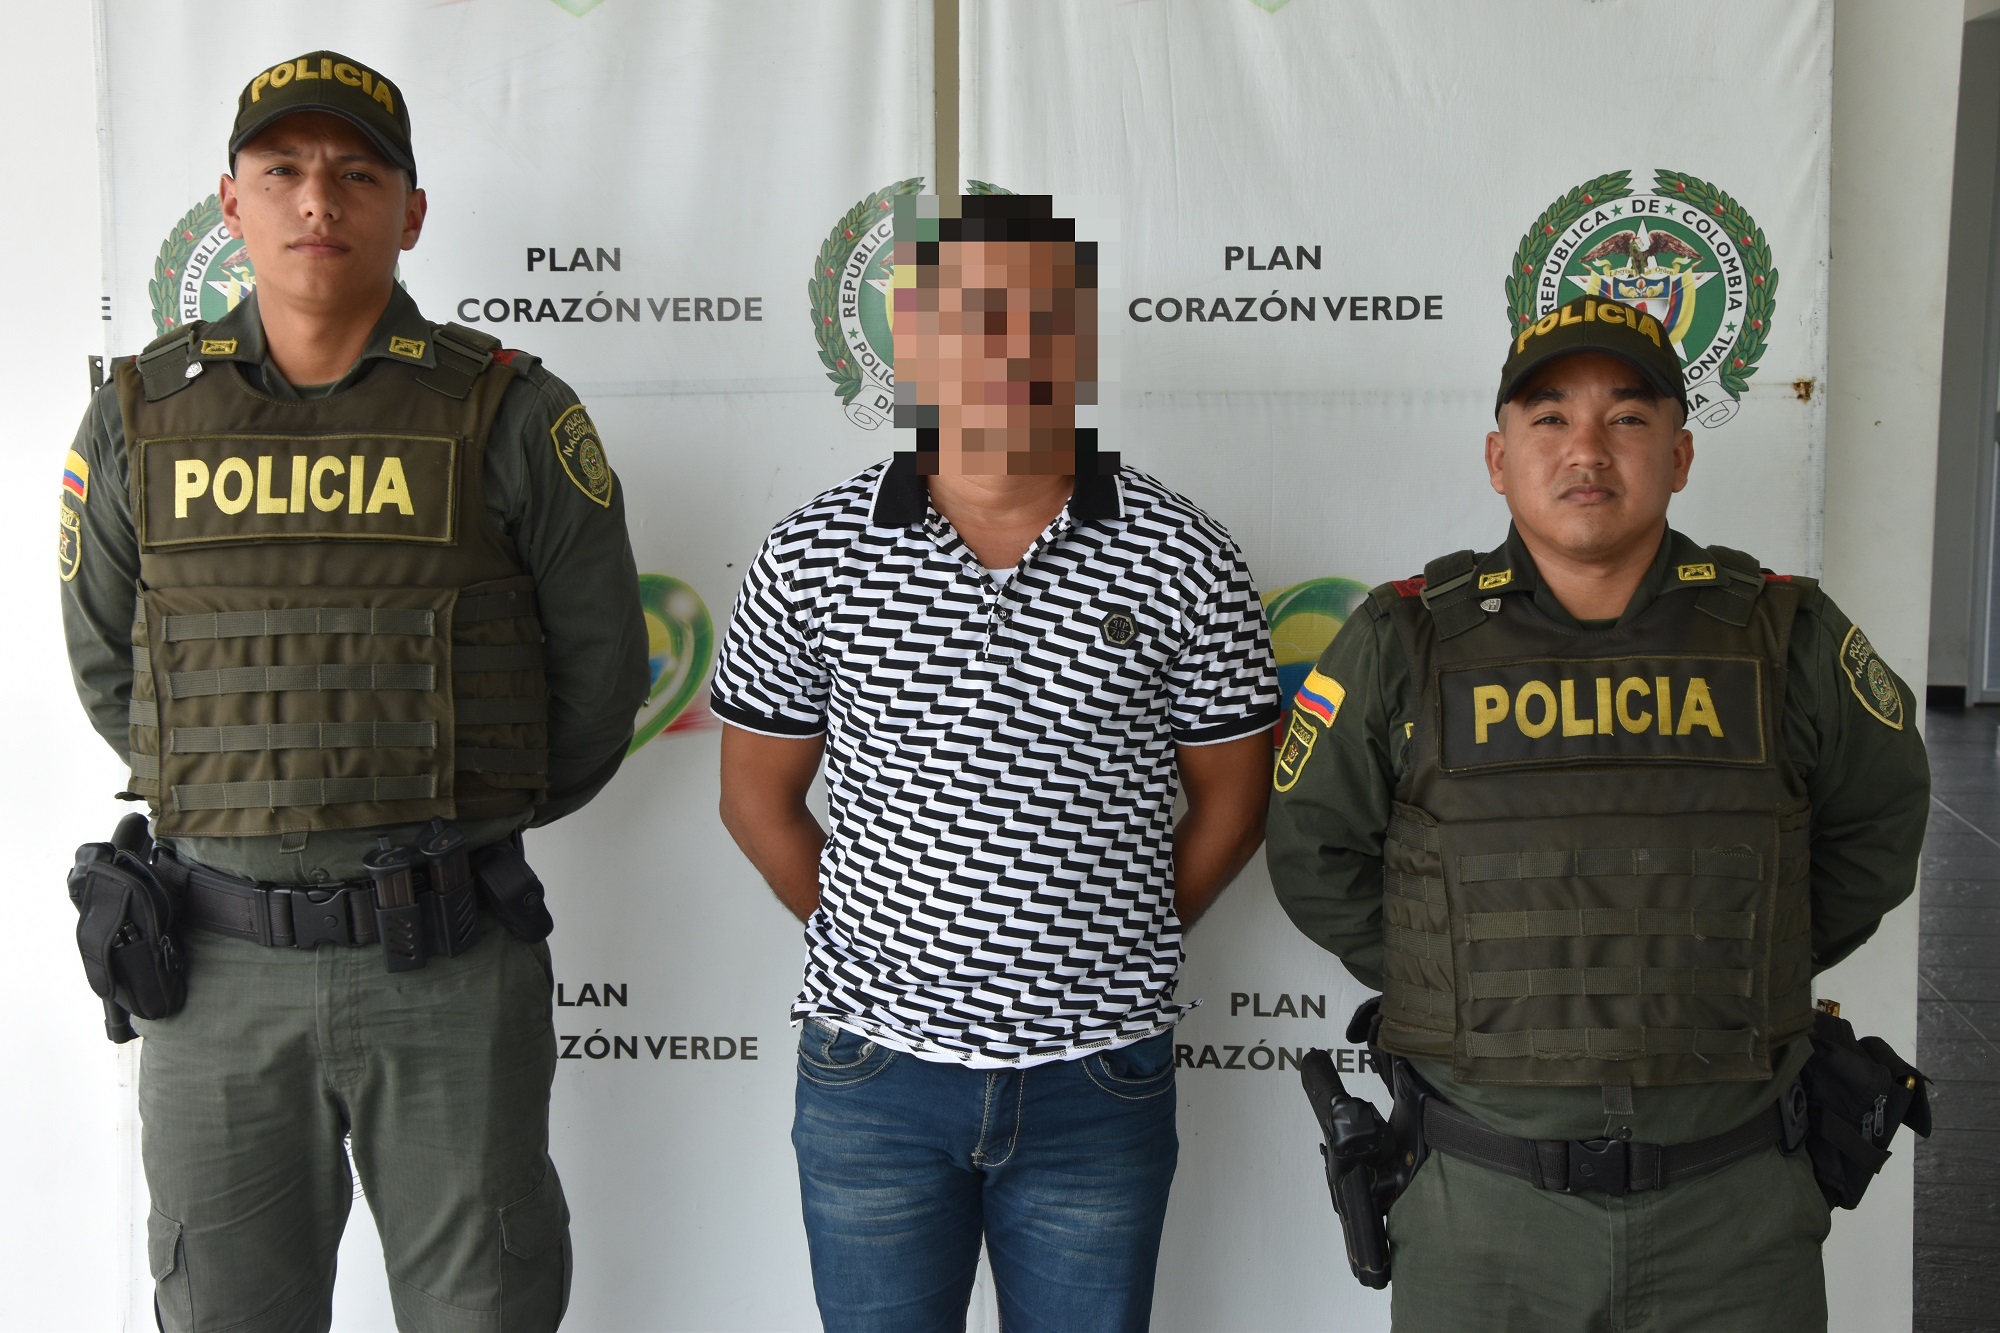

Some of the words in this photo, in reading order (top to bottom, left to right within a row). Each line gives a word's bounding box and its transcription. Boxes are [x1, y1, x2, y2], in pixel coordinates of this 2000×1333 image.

[251, 58, 394, 115] POLICIA
[184, 225, 231, 320] REPÚBLIC
[527, 247, 621, 272] PLAN
[843, 223, 893, 318] REPÚBLIC
[1225, 245, 1322, 271] PLAN
[1541, 210, 1609, 315] REPÚBLICA
[1631, 199, 1660, 214] DE
[1682, 210, 1743, 311] COLOMBIA
[457, 291, 640, 323] CORAZÓN
[646, 296, 763, 323] VERDE
[1128, 289, 1316, 323] CORAZÓN
[1323, 295, 1443, 321] VERDE
[1517, 300, 1661, 354] POLICIA
[853, 341, 894, 388] POLIC
[1683, 335, 1733, 386] IONAL
[175, 455, 415, 519] POLICIA
[1473, 676, 1724, 744] POLICIA
[557, 983, 628, 1007] LAN
[1231, 992, 1326, 1019] PLAN
[644, 1035, 758, 1060] VERDE
[1175, 1039, 1302, 1071] RAZÓN
